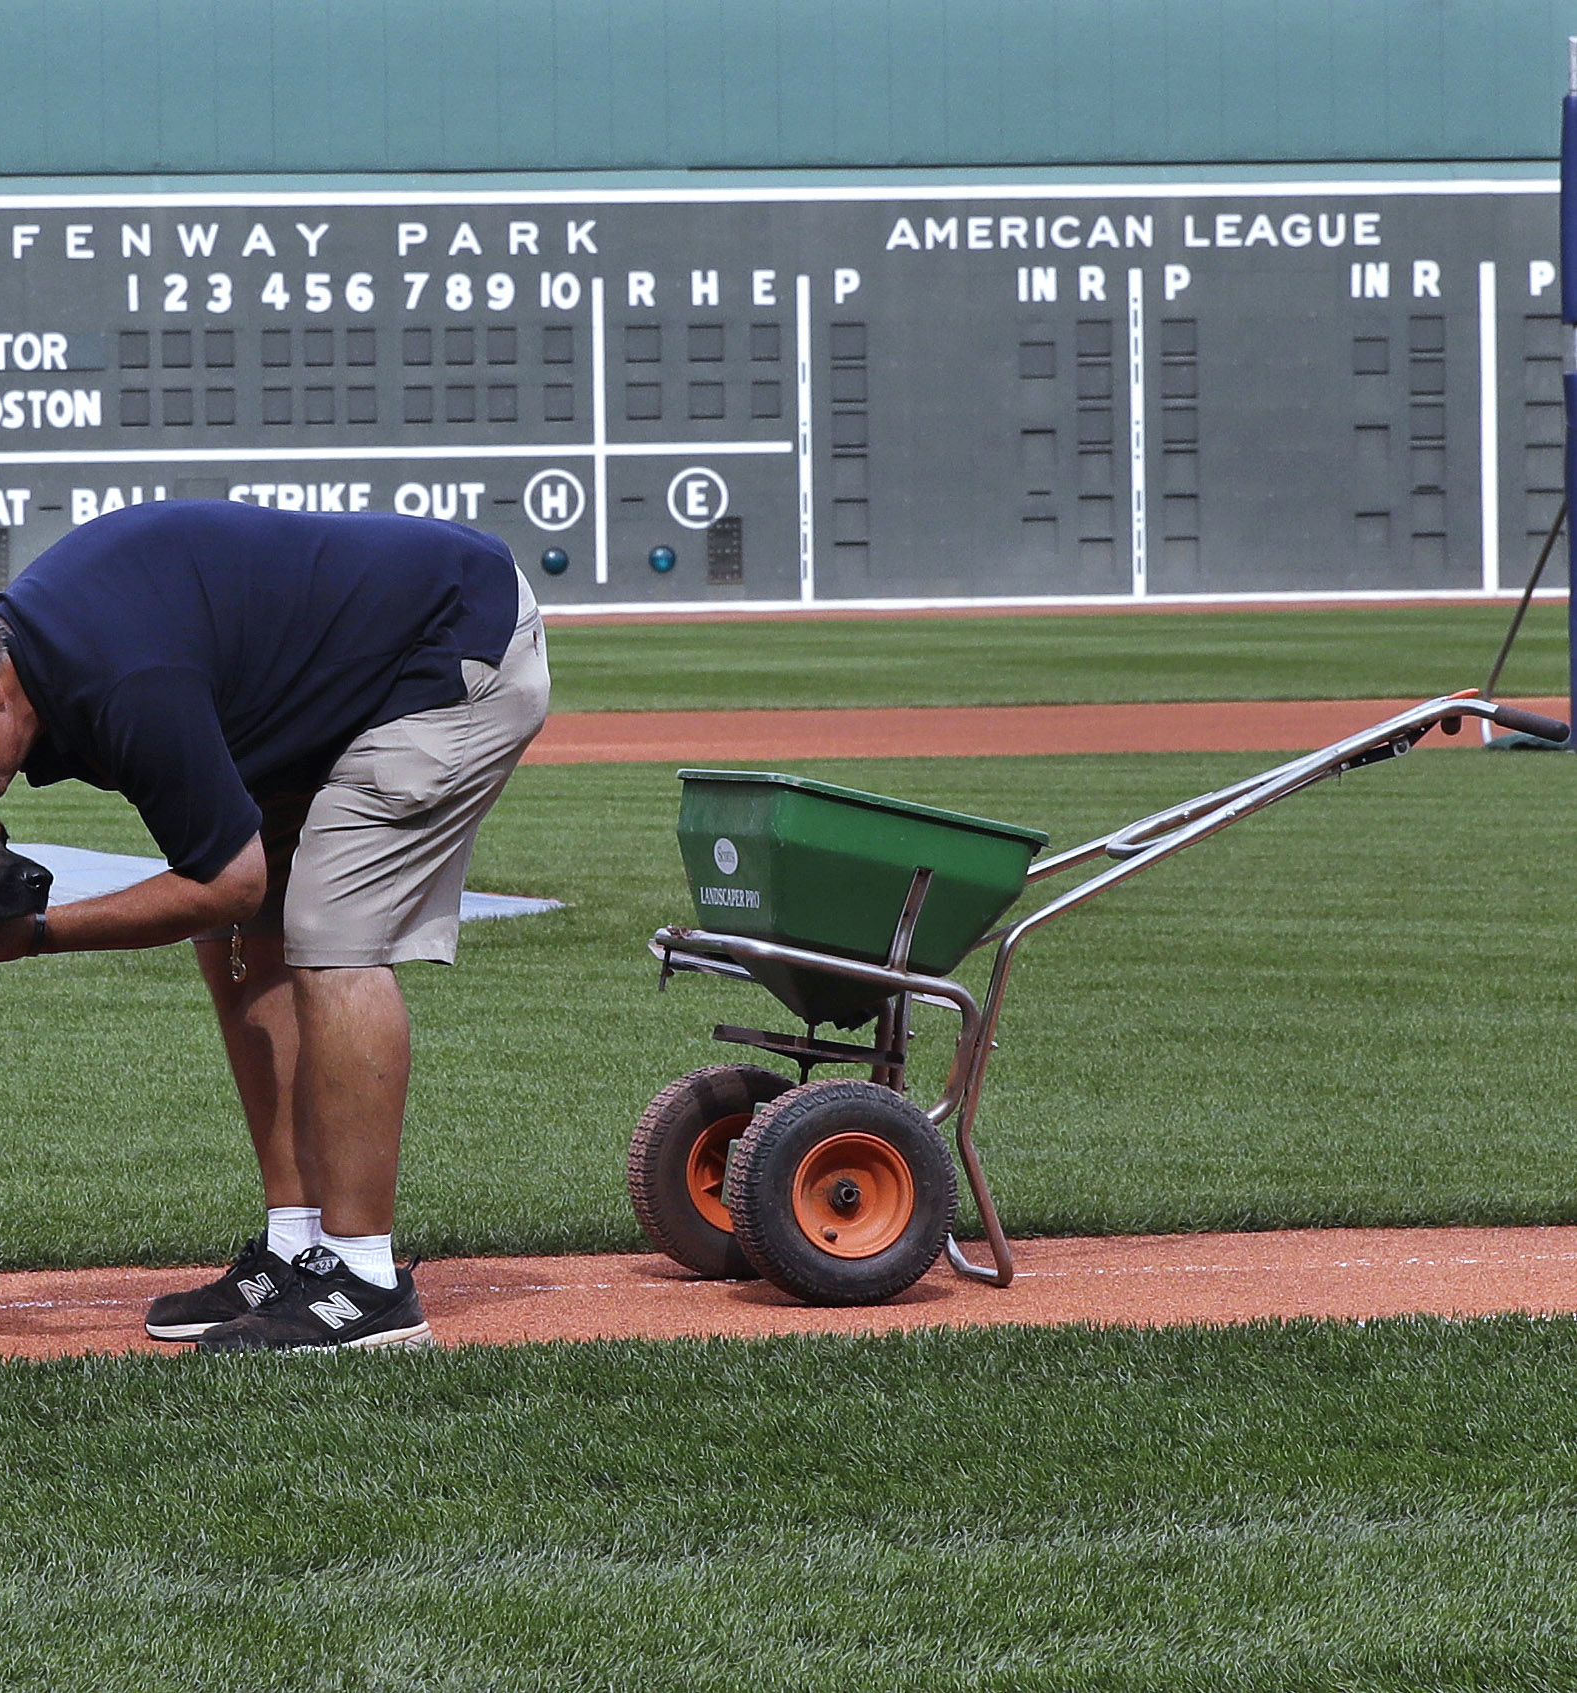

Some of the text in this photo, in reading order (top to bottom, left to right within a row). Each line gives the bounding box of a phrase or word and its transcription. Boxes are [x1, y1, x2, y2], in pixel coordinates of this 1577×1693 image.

[12, 220, 598, 259] FENWAY PARK
[885, 213, 1381, 251] AMERICAN LEAGUE
[127, 271, 581, 314] 1 2 3 4 5 6 7 8 9 10
[627, 269, 776, 307] R H E
[834, 268, 862, 304] P
[1017, 265, 1107, 302] IN R
[1164, 264, 1191, 301] P
[1351, 260, 1441, 298] IN R
[1529, 260, 1556, 296] P
[393, 482, 486, 521] OUT
[700, 887, 760, 908] LANDSCAPER PRO
[308, 1290, 364, 1331] N
